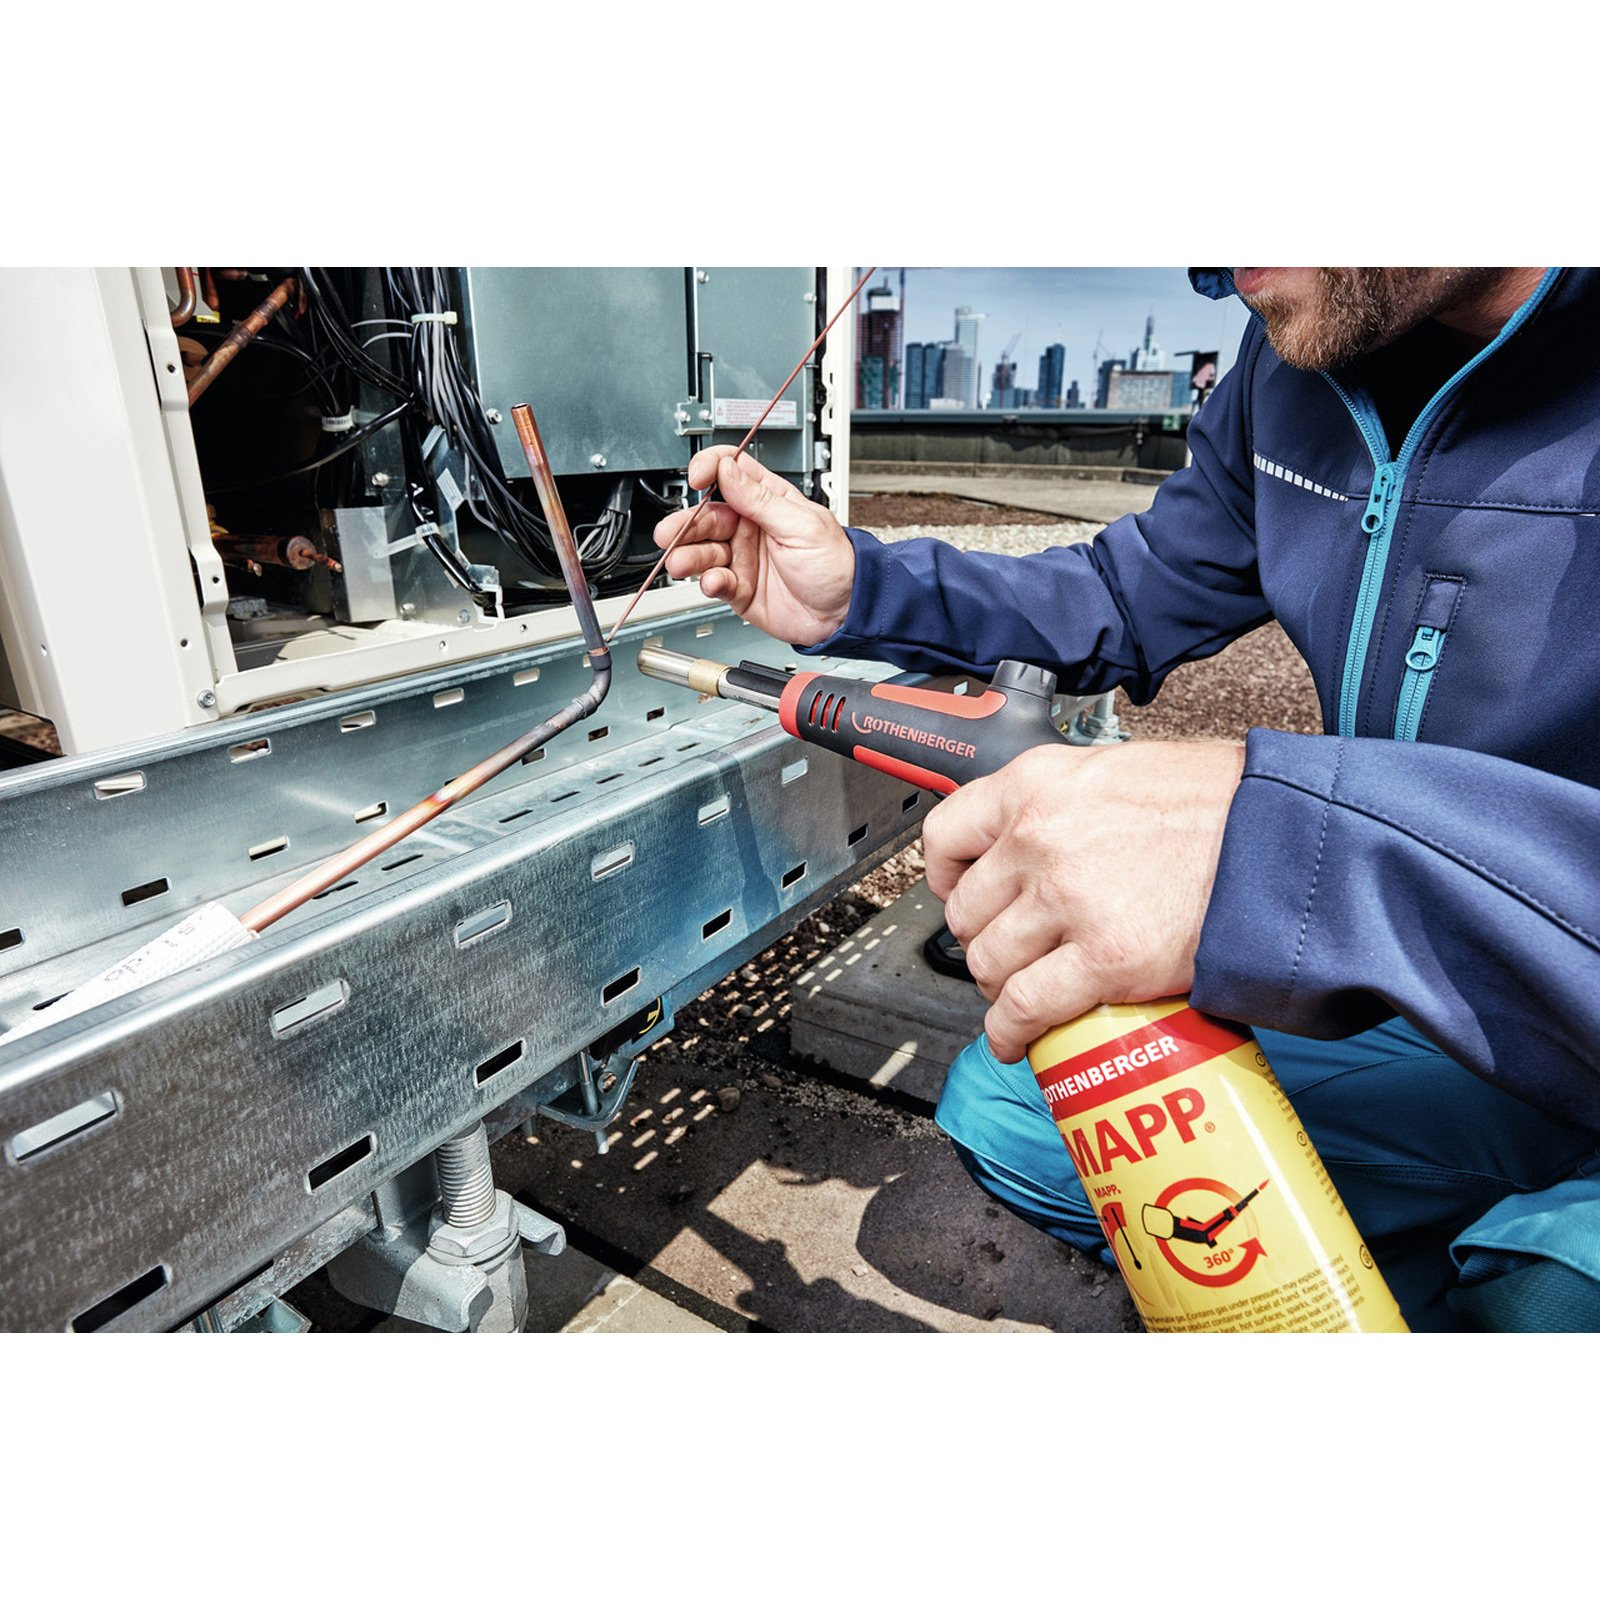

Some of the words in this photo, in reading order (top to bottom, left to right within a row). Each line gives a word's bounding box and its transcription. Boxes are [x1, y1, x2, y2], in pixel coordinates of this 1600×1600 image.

[863, 715, 976, 759] ROTHENBERGER
[1043, 1035, 1180, 1105] OTHENBERGER
[1212, 1313, 1243, 1325] container
[1253, 1301, 1272, 1314] label
[1272, 1299, 1281, 1308] at
[1302, 1282, 1319, 1294] Keep
[1228, 1299, 1249, 1311] under
[1282, 1281, 1298, 1291] may
[1239, 1321, 1253, 1330] hot
[1311, 1292, 1328, 1303] open
[1286, 1315, 1309, 1327] unless
[1307, 1307, 1321, 1318] leak
[1321, 1301, 1334, 1311] can
[1311, 1318, 1328, 1329] Store
